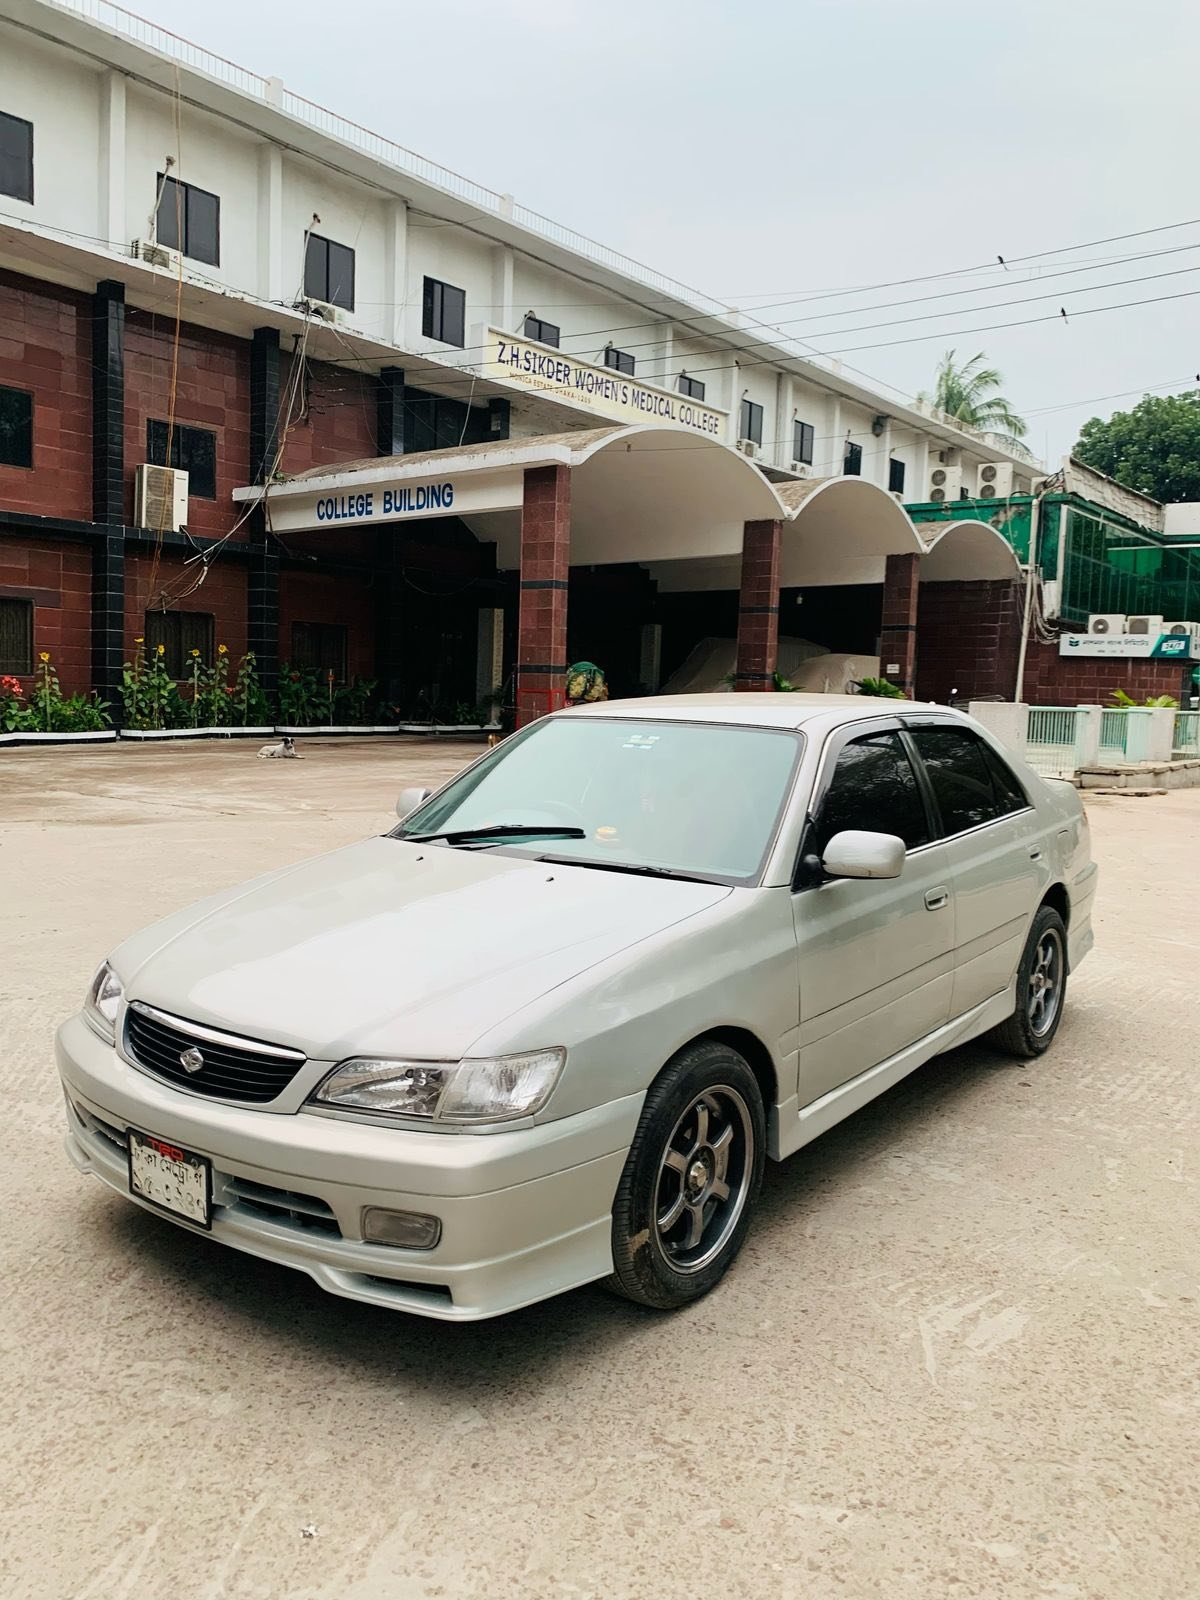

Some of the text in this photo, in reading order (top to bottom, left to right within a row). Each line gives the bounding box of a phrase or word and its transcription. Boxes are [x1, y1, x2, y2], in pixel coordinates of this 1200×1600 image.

[497, 341, 720, 435] Z.H.SIKDER WOMEN'S MEDICAL COLLEGE
[316, 482, 454, 521] COLLEGE BUILDING
